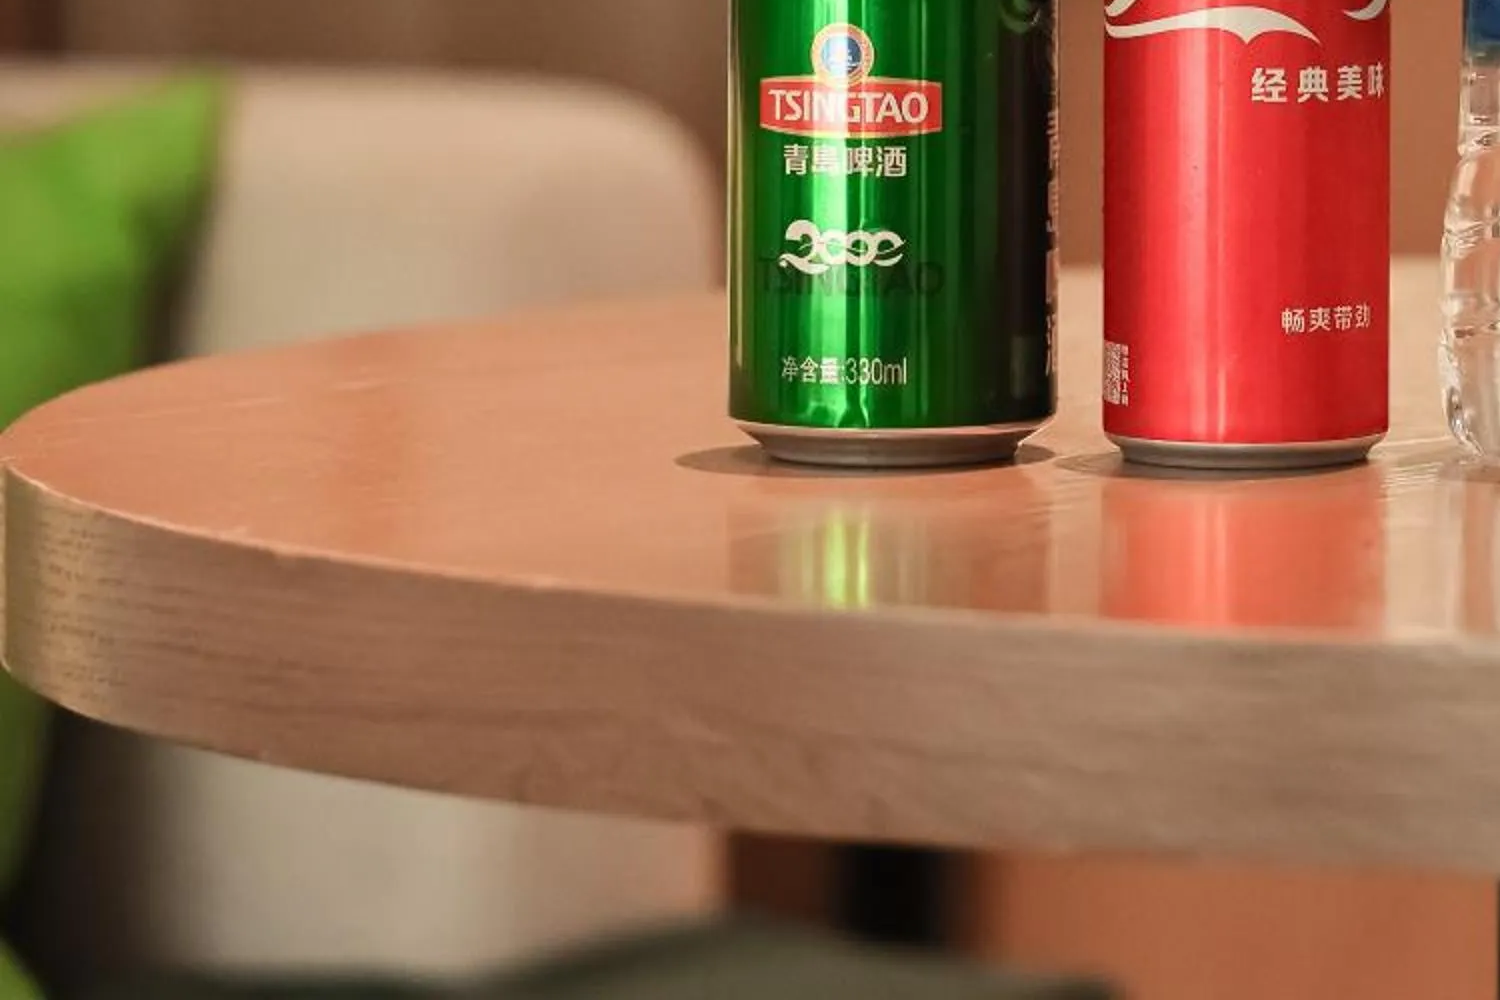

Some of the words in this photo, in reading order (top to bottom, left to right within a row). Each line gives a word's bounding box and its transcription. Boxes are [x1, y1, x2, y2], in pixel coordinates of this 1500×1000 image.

[1251, 62, 1385, 103] 经典美味
[767, 88, 930, 124] TSINGTAO
[1281, 302, 1371, 334] 畅爽带劲
